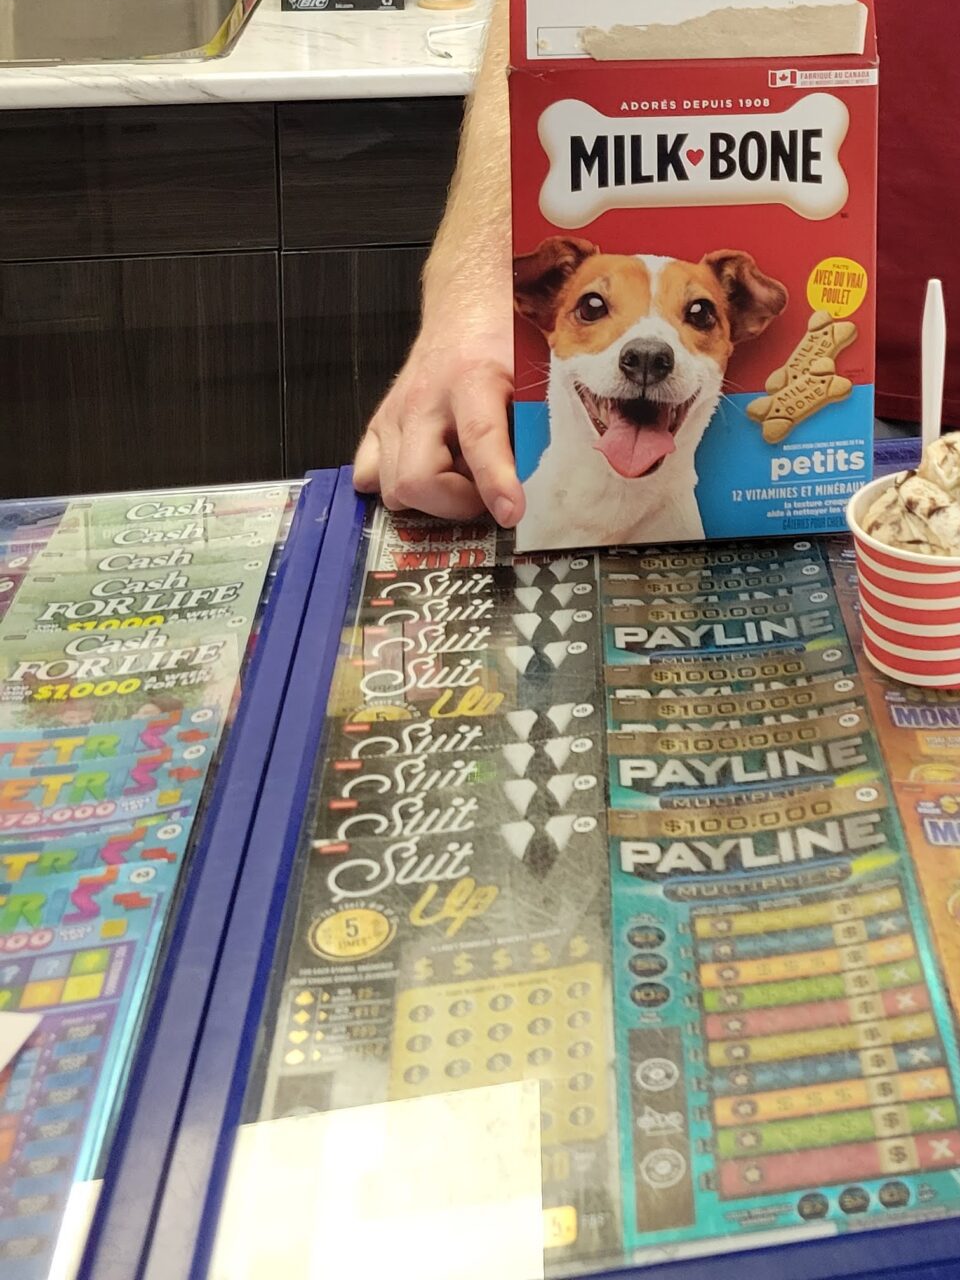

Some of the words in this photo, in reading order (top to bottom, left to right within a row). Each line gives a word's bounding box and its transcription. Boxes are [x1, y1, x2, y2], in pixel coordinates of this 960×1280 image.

[620, 99, 677, 111] ADORÉS
[683, 98, 732, 109] DEPUIS
[739, 97, 771, 108] 1908
[569, 132, 689, 192] MILK
[709, 128, 823, 185] BONE
[813, 269, 832, 286] AVEC
[834, 270, 844, 286] DU
[845, 271, 864, 288] VRAI
[821, 288, 852, 305] POULET
[789, 334, 819, 370] MILK
[777, 376, 817, 405] MILK
[785, 387, 825, 416] BONE
[771, 448, 865, 481] petits
[732, 489, 742, 502] 12
[745, 487, 798, 501] VITAMINES
[801, 486, 812, 497] ET
[815, 480, 865, 497] MINÉRAUX
[125, 496, 216, 521] Cash
[112, 522, 206, 546] Cash
[36, 595, 137, 622] FOR
[138, 581, 244, 613] LIFE
[614, 609, 834, 649] PAYLINE
[8, 655, 112, 683] FOR
[115, 640, 226, 675] LIFE
[34, 677, 143, 702] $1,000
[360, 653, 482, 701] Suit
[618, 736, 868, 787] PAYLINE
[327, 836, 474, 903] Suit
[677, 868, 843, 897] MULTIPLIER
[408, 878, 499, 937] Up
[344, 917, 359, 938] 5
